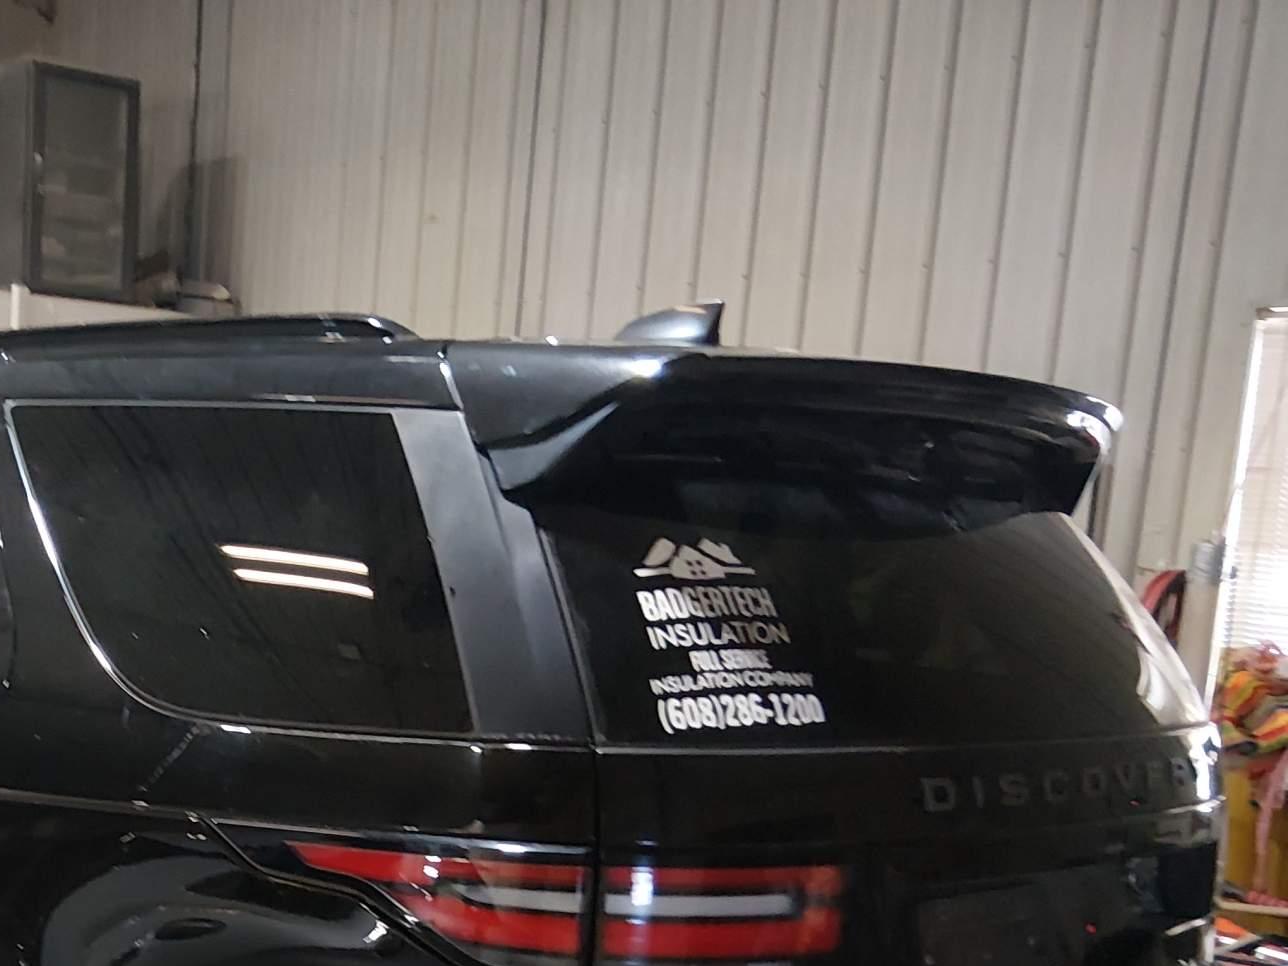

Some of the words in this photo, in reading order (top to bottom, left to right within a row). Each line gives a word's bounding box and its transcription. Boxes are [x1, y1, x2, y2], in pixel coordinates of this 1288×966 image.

[635, 585, 779, 622] BADGERTECH
[646, 621, 791, 650] INSULATION
[920, 756, 1214, 813] DISCOVER
